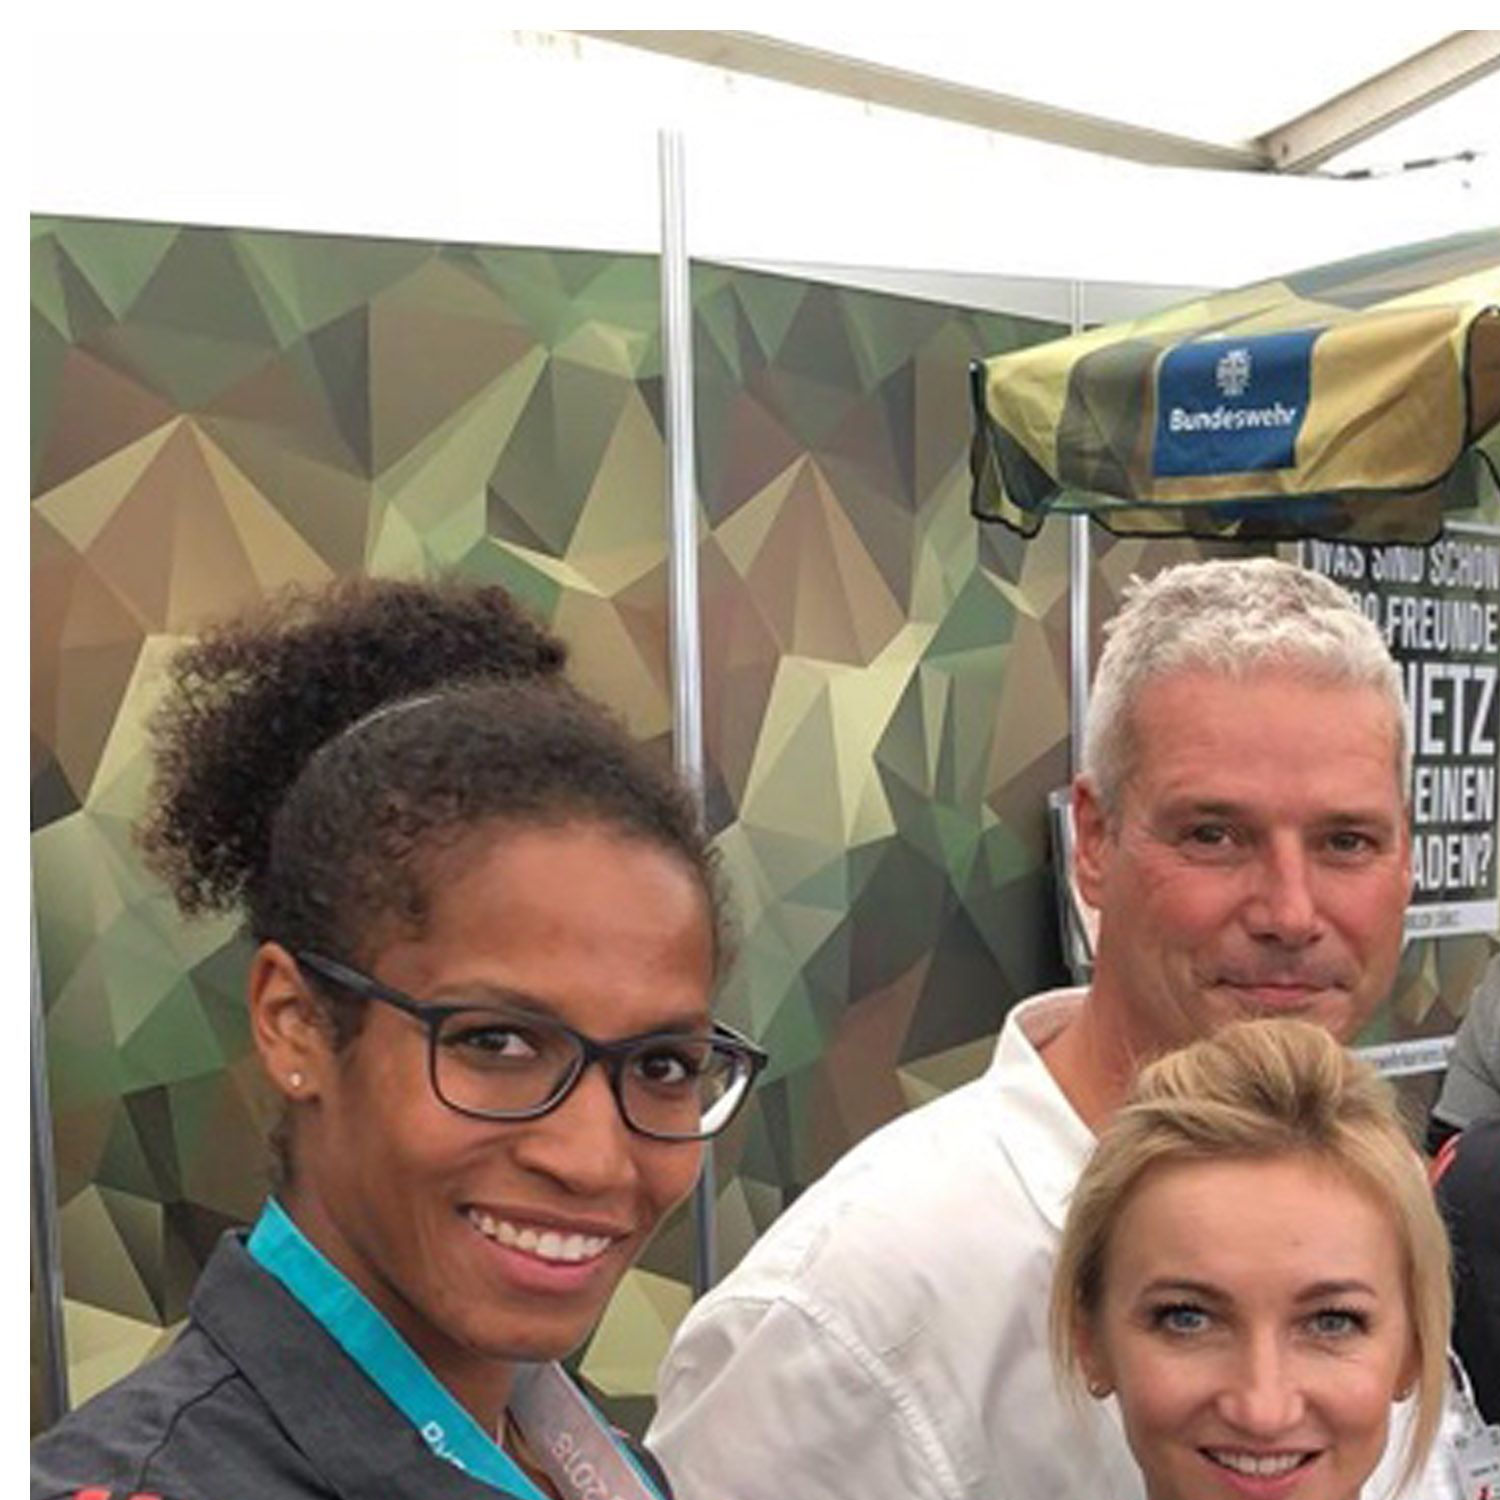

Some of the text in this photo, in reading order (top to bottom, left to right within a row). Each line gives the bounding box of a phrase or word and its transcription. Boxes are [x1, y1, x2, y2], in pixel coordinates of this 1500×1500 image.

[1169, 401, 1297, 432] Bundeswehr
[1310, 539, 1365, 579] WAS
[1386, 595, 1498, 653] FREUNDE
